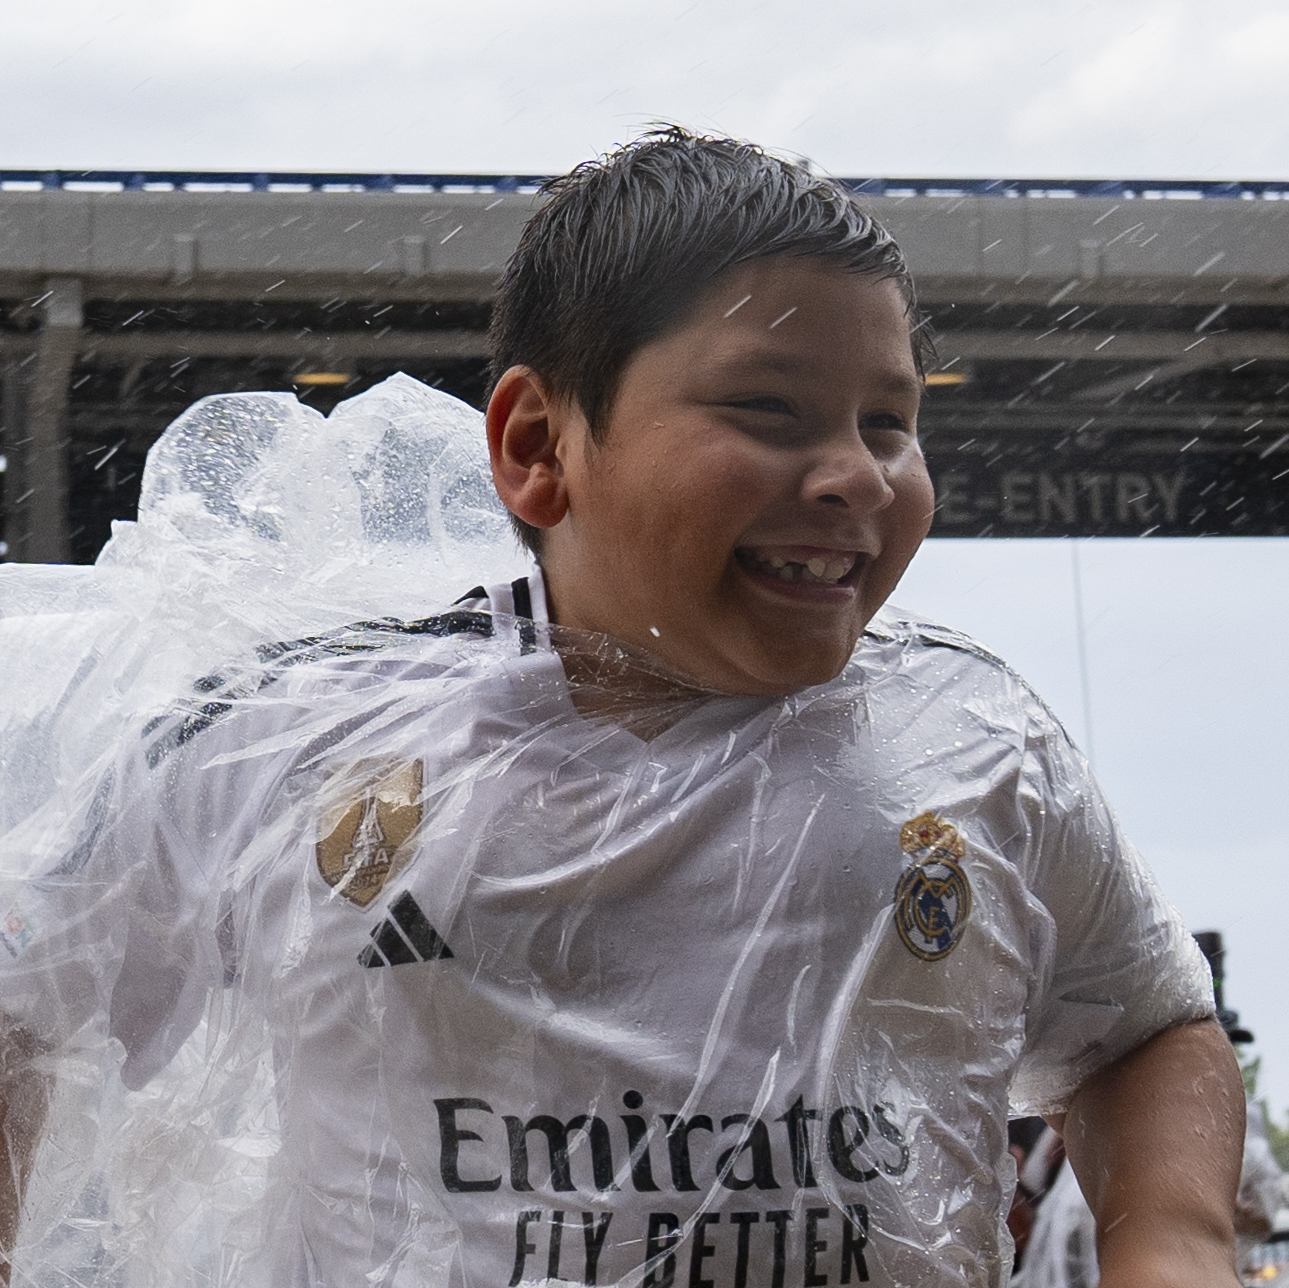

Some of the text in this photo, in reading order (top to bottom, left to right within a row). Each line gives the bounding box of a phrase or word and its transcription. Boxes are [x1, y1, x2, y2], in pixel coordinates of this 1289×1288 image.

[940, 471, 1186, 525] E-ENTRY
[433, 1089, 911, 1194] Emirates
[507, 1209, 614, 1288] FLY
